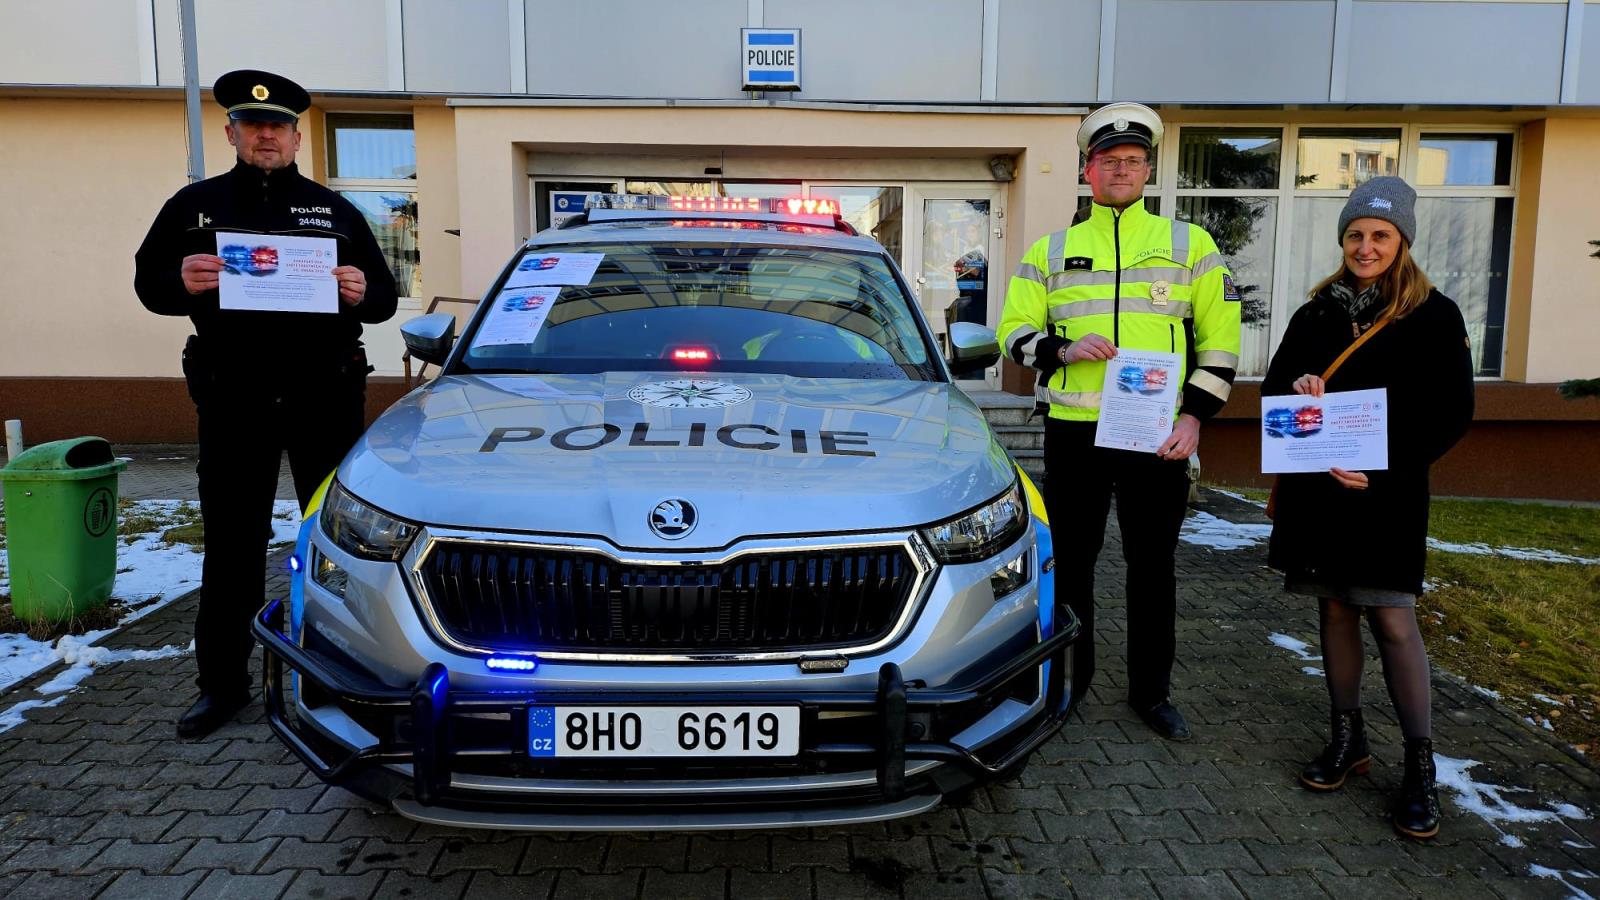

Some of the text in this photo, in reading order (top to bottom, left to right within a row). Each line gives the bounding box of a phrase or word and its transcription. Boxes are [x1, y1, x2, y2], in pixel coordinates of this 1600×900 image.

[748, 50, 795, 65] POLICIE
[290, 206, 332, 215] POLICIE
[298, 218, 332, 229] 244859
[478, 422, 877, 457] POLICIE
[566, 712, 779, 751] 8H0 6619
[532, 738, 552, 751] CZ
